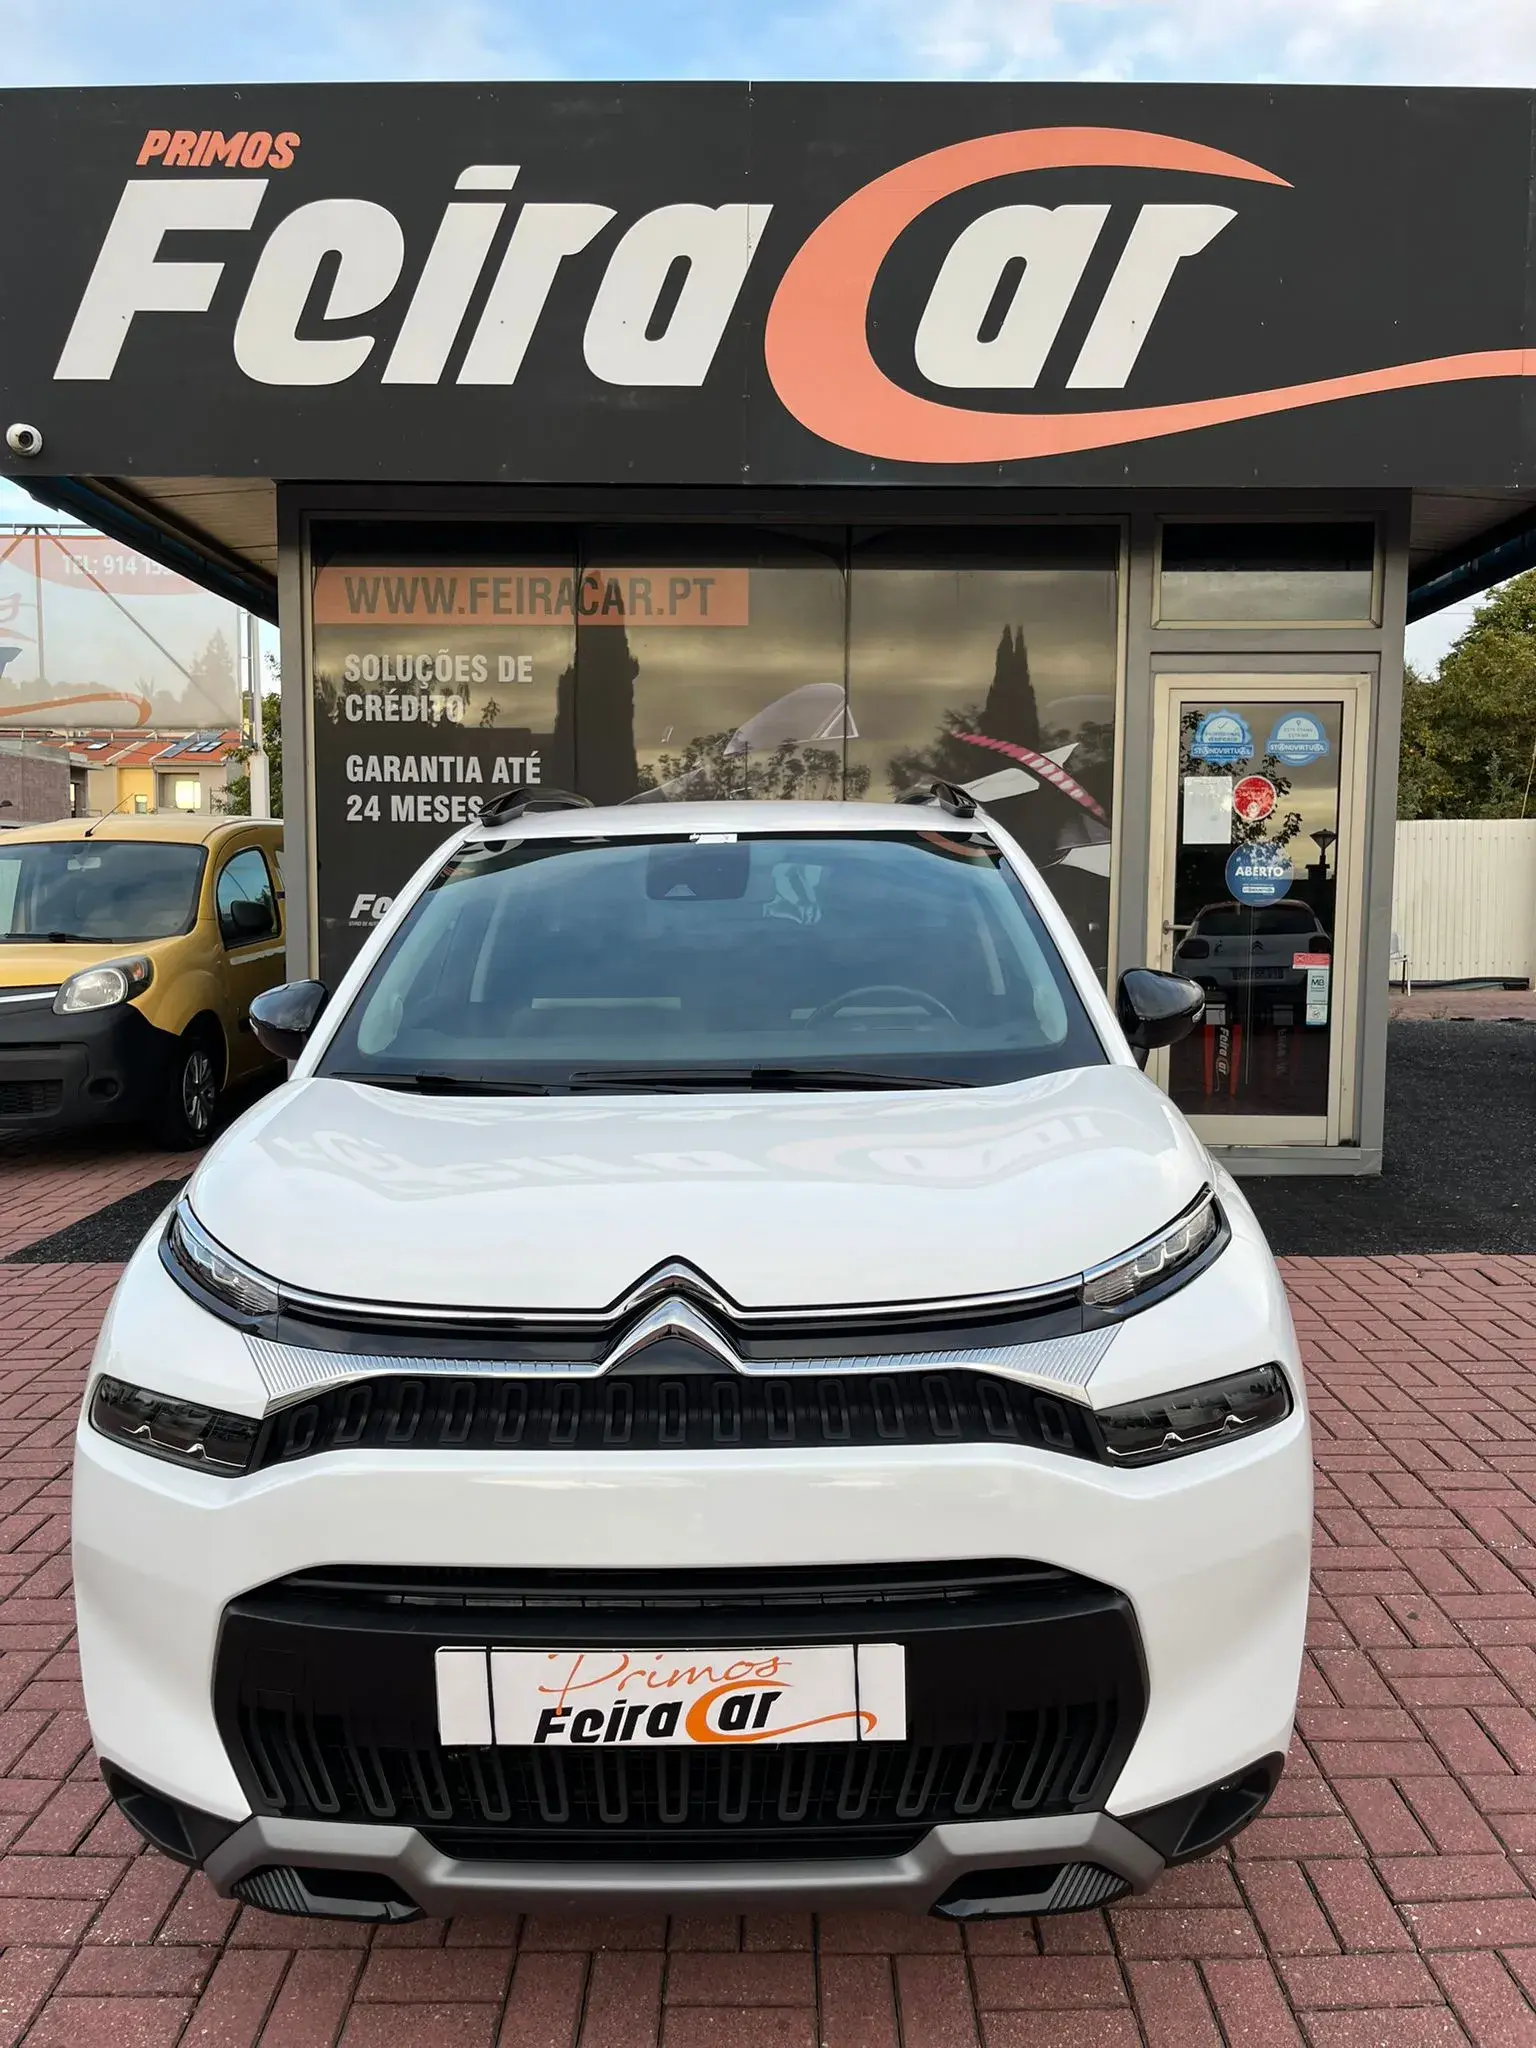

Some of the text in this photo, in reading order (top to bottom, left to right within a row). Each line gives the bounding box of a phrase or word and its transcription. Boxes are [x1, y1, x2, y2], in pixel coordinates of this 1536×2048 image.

[136, 129, 301, 169] PRIMOS
[103, 554, 138, 576] 914
[344, 576, 716, 617] WWW.FEIRACAR.PT
[344, 649, 534, 689] SOLUÇÕES DE
[344, 691, 465, 723] CRÉDITO
[346, 751, 542, 784] GARANTIA ATÉ
[346, 794, 485, 823] 24 MESES
[1235, 866, 1284, 877] ABERTO
[538, 1653, 793, 1715] Primos
